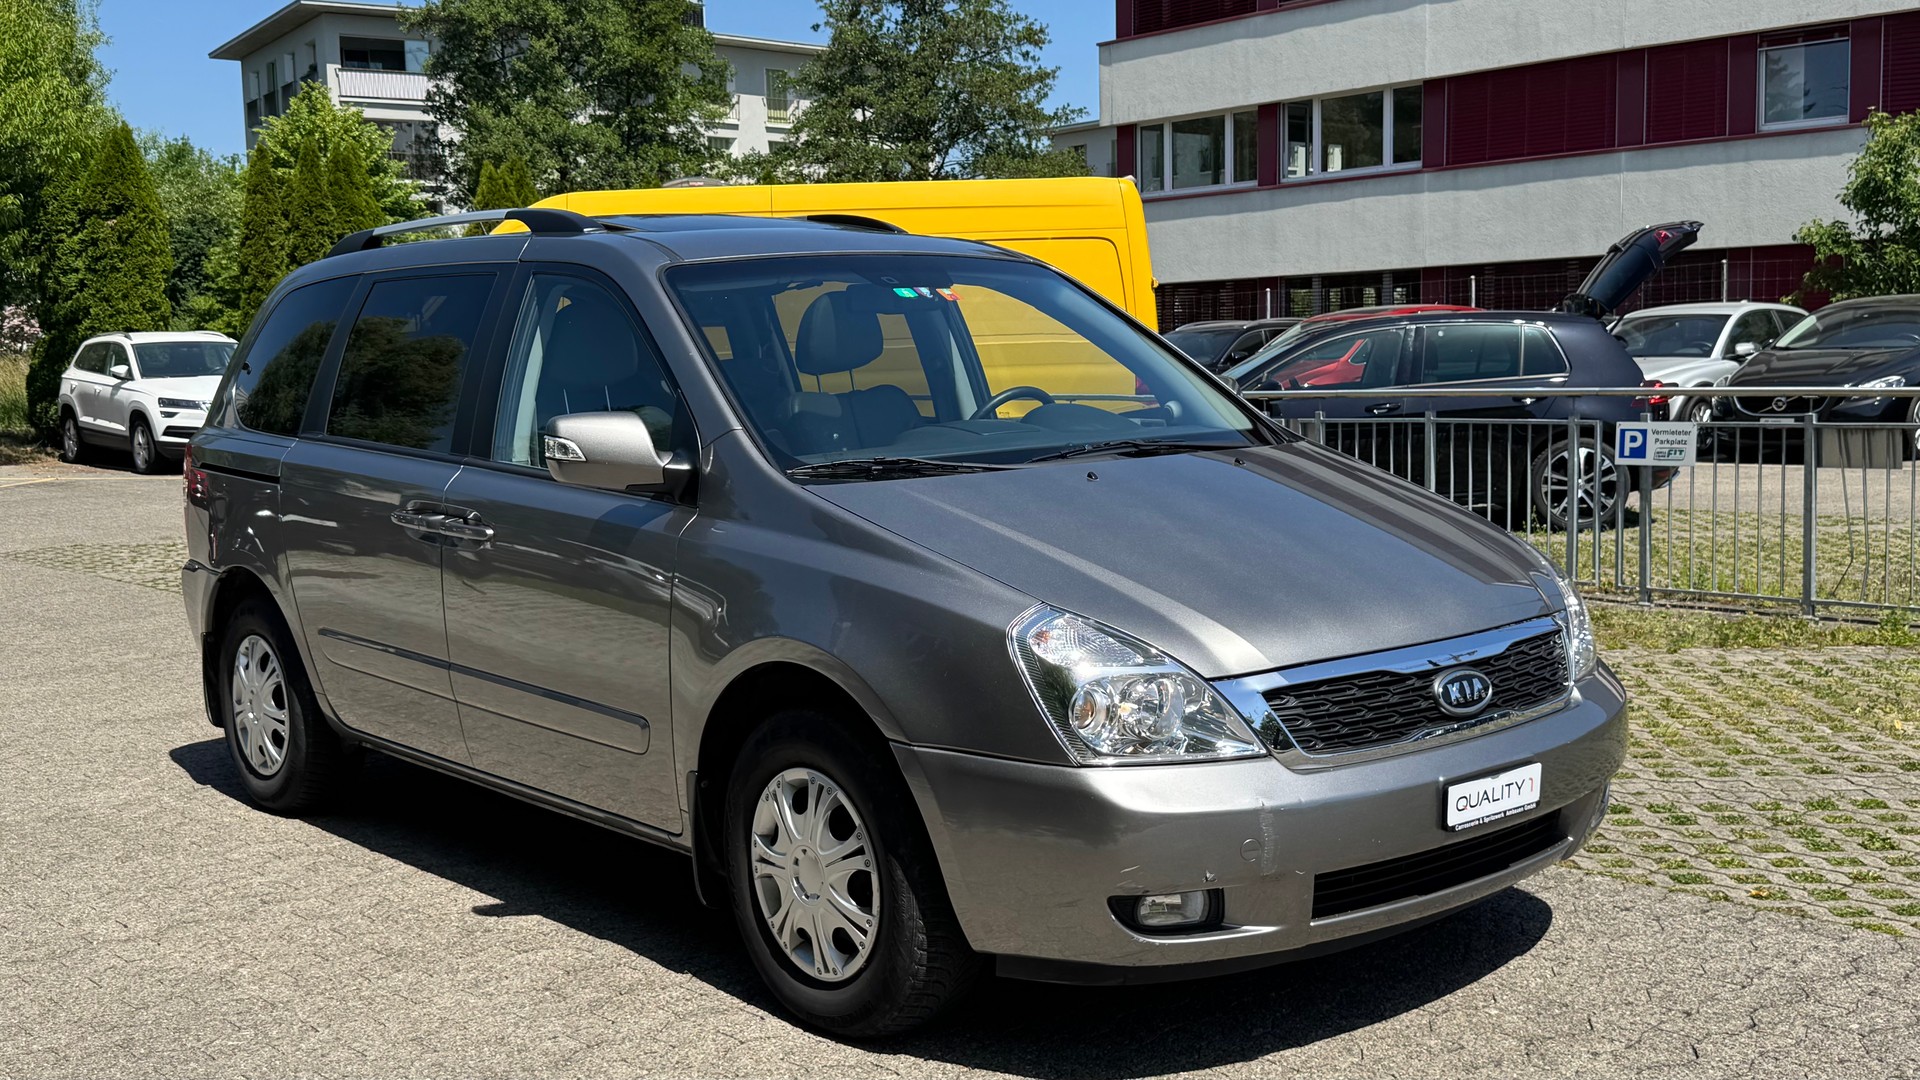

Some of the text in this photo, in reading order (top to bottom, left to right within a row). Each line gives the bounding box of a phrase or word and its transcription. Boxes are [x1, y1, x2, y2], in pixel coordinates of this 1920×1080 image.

[1651, 428, 1692, 436] Vermieteter
[1623, 430, 1643, 457] P
[1654, 438, 1688, 446] Parkplatz
[1667, 449, 1685, 458] FIT
[1446, 678, 1486, 705] KIA
[1456, 779, 1526, 812] QUALITY
[1524, 802, 1537, 811] GmbH
